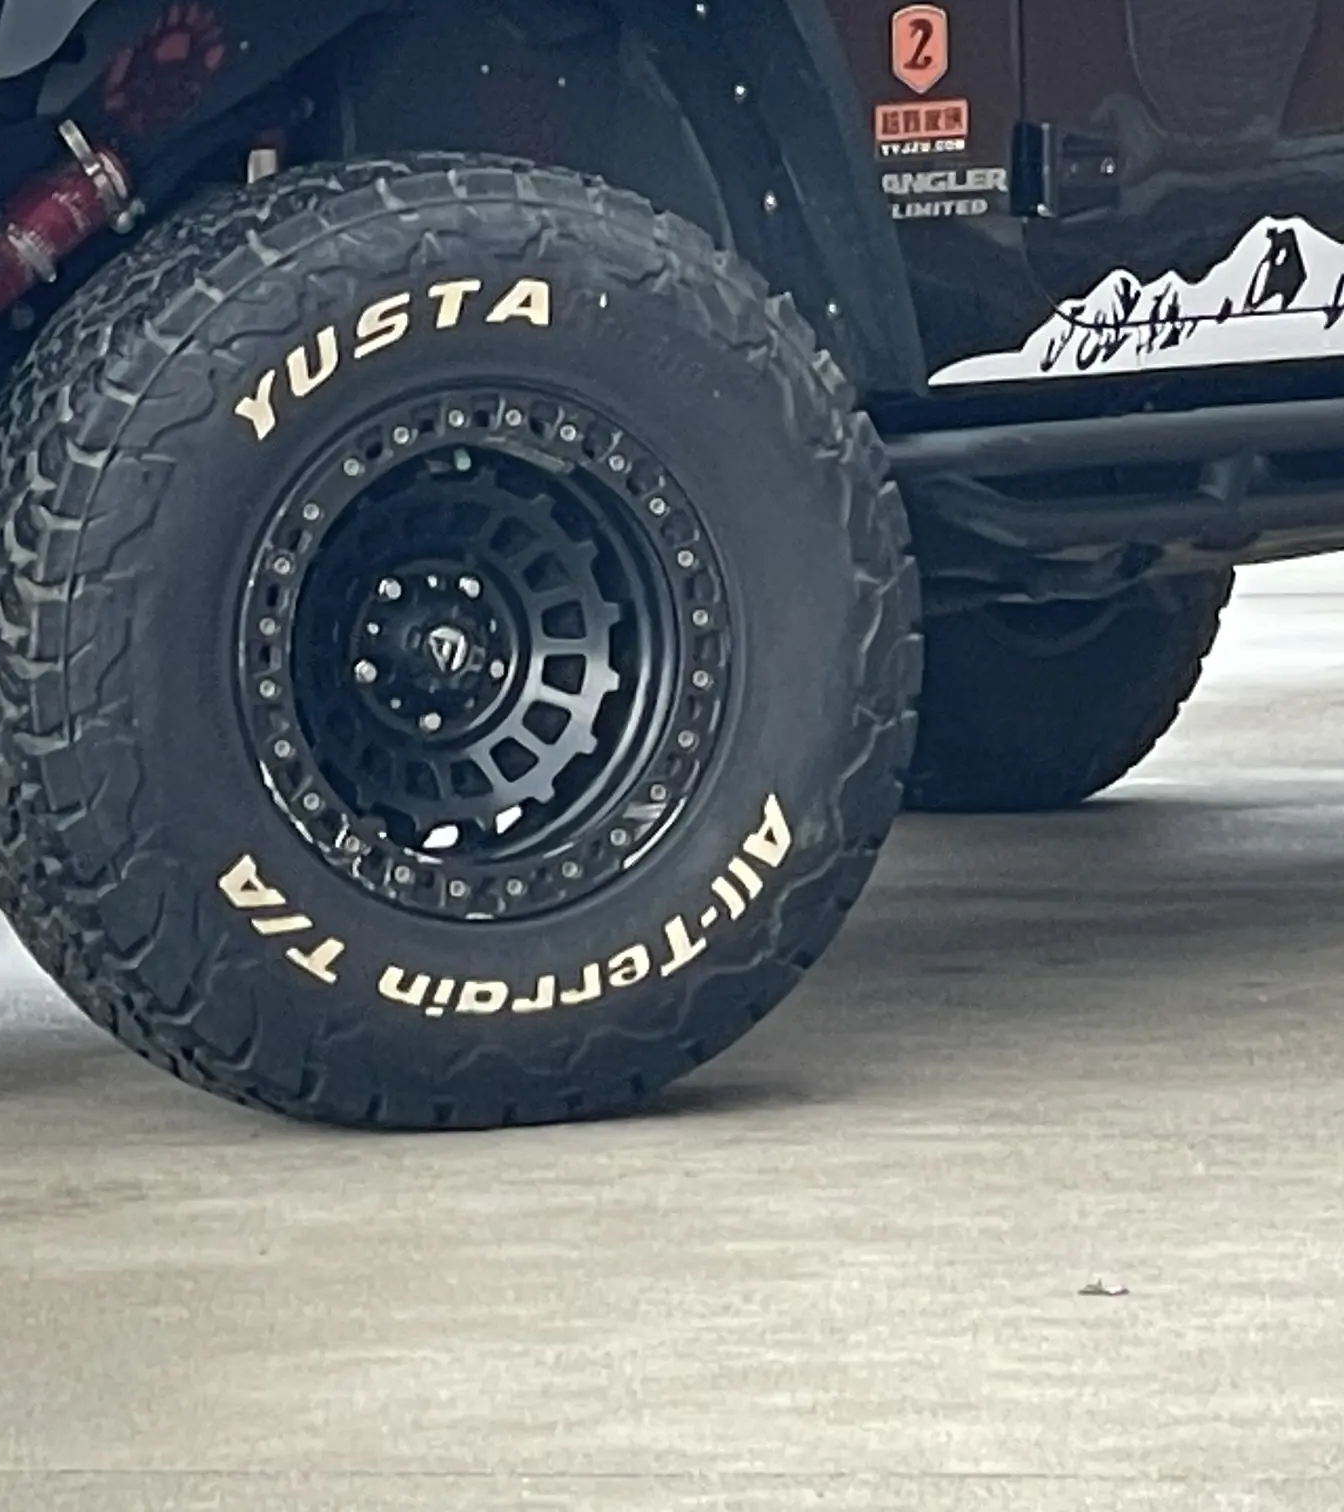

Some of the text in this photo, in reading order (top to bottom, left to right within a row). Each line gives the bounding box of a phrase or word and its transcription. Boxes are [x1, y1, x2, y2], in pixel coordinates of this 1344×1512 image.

[234, 279, 552, 440] YUSTA
[218, 793, 793, 1017] All-Terrain T/A
